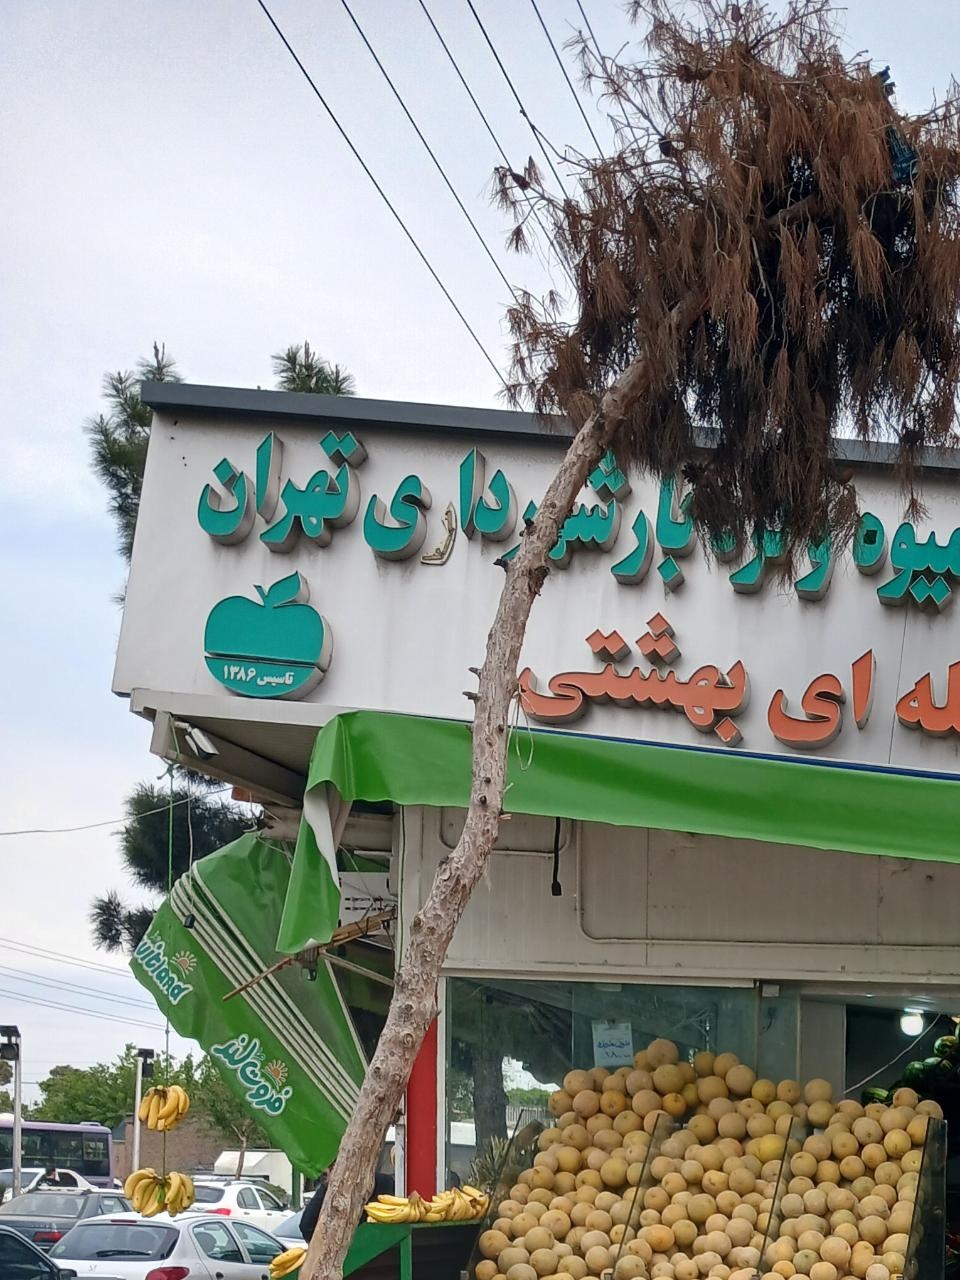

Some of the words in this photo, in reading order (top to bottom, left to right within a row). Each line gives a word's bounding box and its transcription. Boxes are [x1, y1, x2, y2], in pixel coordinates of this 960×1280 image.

[198, 429, 369, 553] تهران
[361, 446, 626, 566] شرداری
[222, 664, 257, 682] ۱۳۸۶
[519, 612, 751, 748] بهشتی
[767, 648, 877, 749] ای
